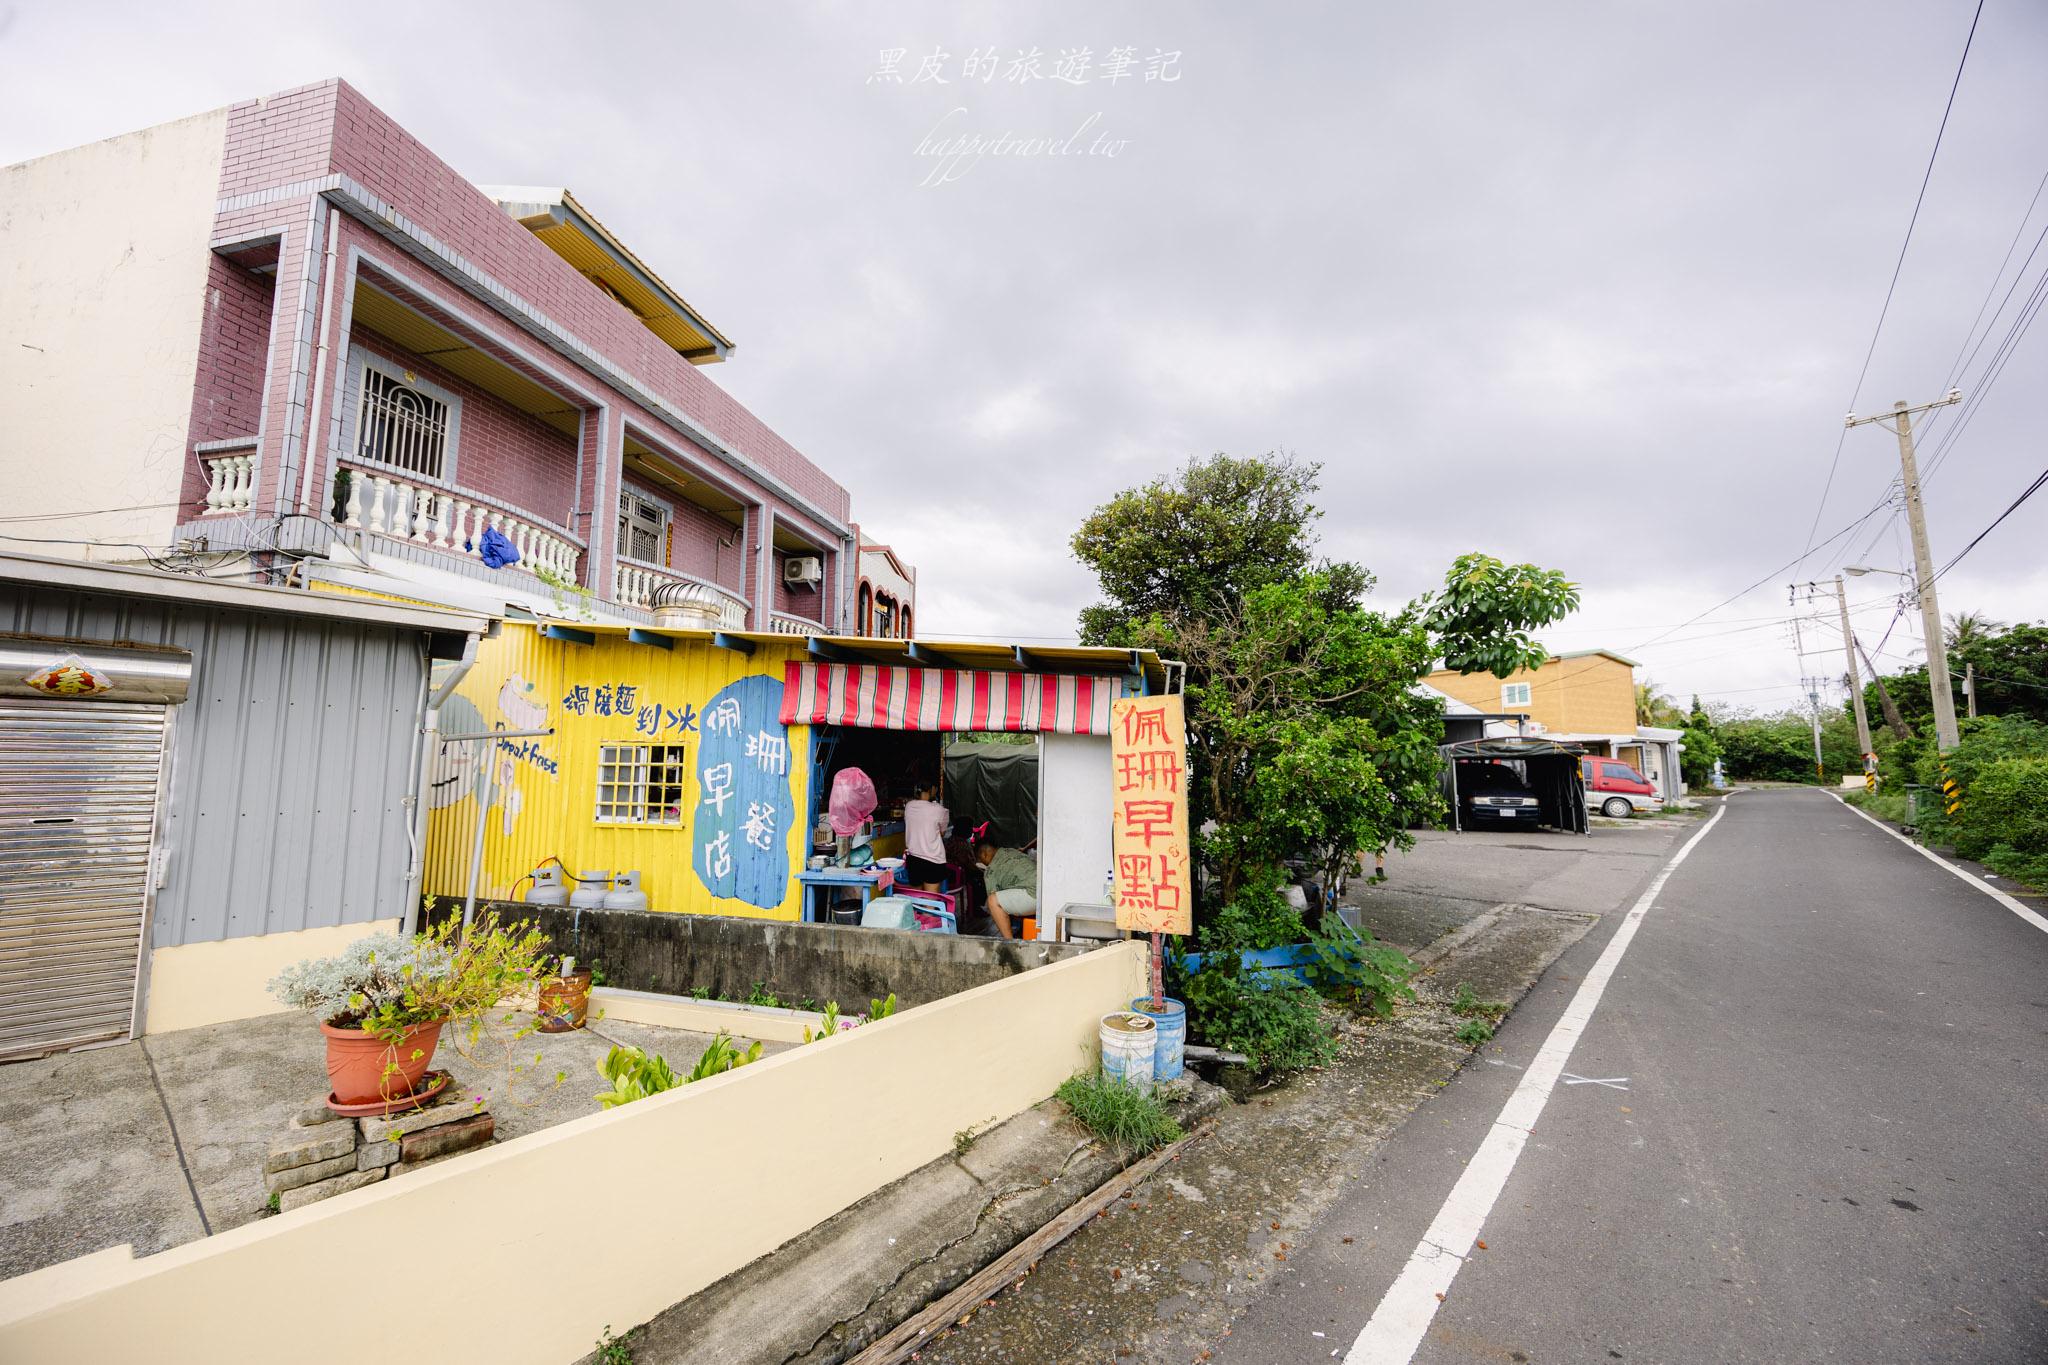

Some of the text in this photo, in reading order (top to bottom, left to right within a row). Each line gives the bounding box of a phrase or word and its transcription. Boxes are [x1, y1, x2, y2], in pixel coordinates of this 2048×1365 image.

[54, 666, 92, 694] 春
[1116, 704, 1183, 912] 佩珊早點
